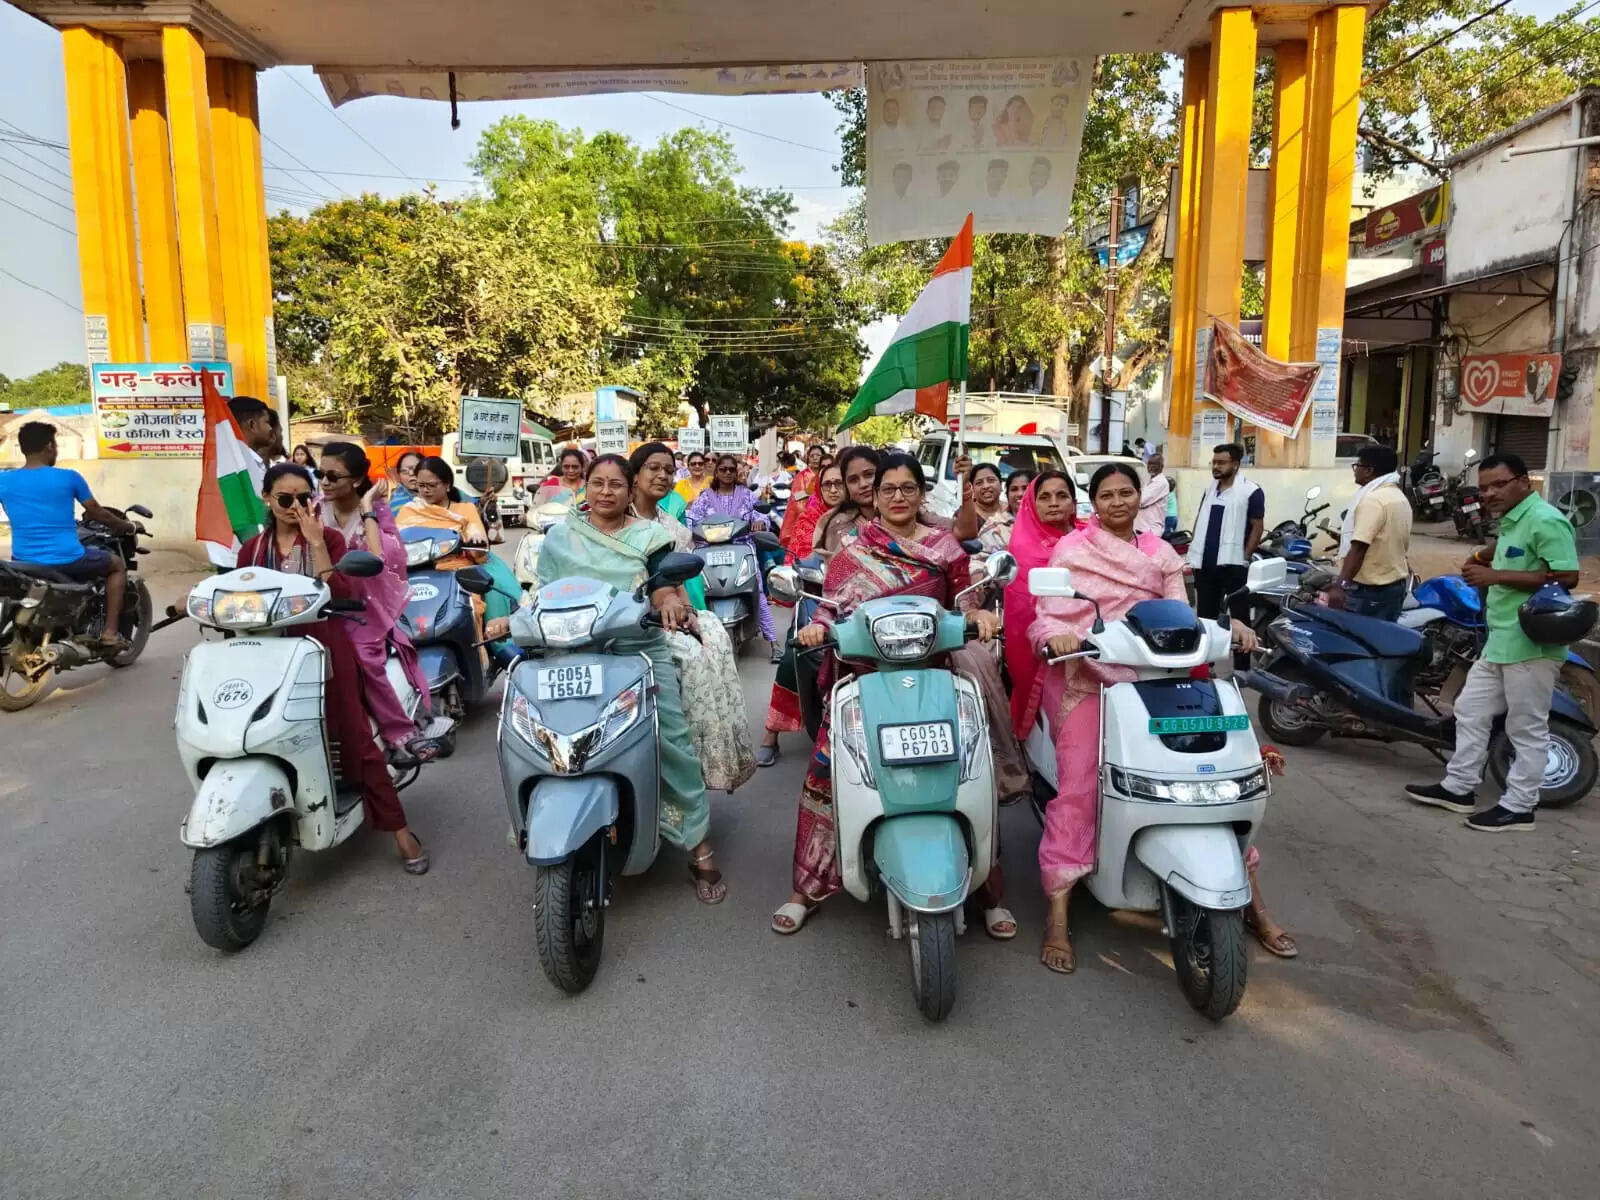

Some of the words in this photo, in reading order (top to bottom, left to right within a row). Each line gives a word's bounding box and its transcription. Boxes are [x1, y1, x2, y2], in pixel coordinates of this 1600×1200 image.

[99, 366, 226, 392] गढ़-कलेा
[134, 411, 197, 425] भोजनालय
[548, 665, 592, 682] CG05A
[549, 679, 592, 698] T5547
[900, 725, 947, 741] CG05A
[902, 739, 949, 756] P6703
